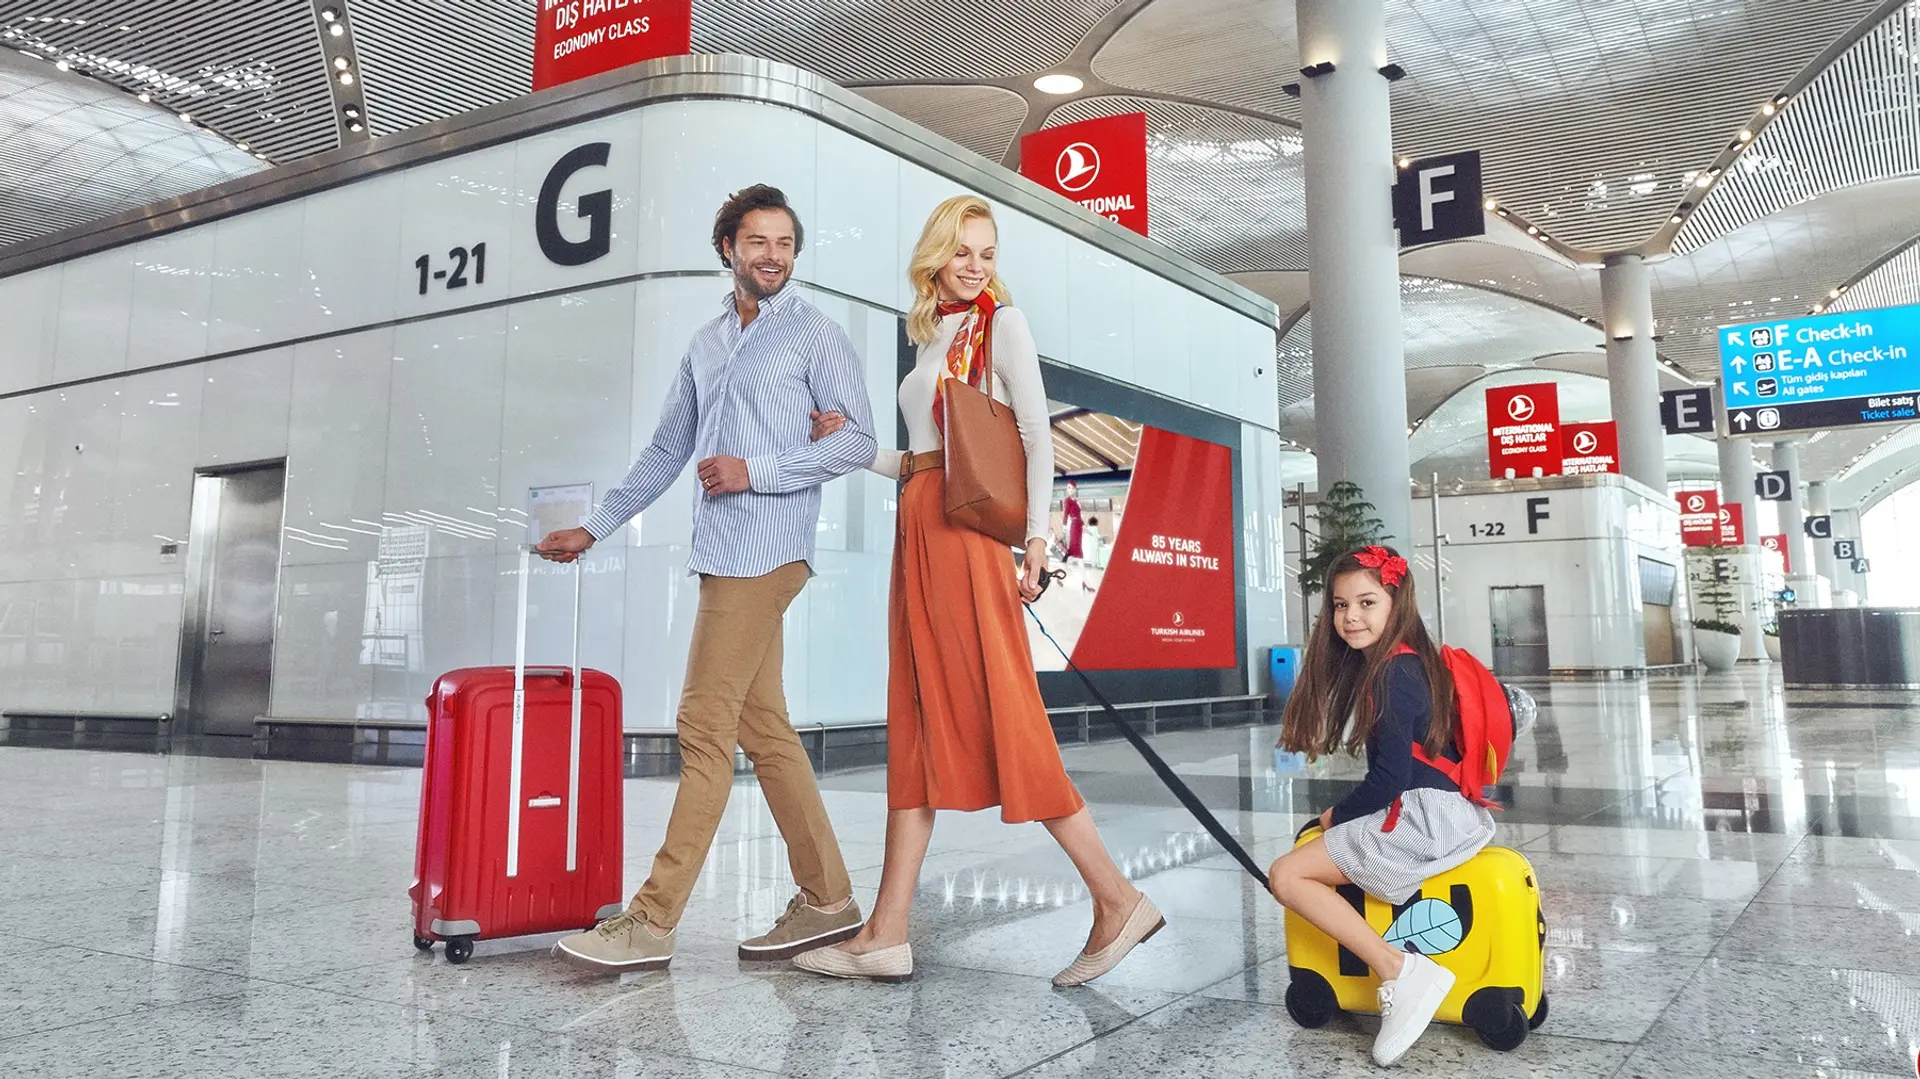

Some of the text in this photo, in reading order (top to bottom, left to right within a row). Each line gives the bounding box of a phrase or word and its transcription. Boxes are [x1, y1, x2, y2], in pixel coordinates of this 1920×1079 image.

[555, 1, 579, 30] DIŞ
[554, 16, 650, 60] ECONOMY CLASS
[535, 142, 613, 267] G
[1418, 164, 1455, 231] F
[415, 242, 486, 295] 1-21
[1774, 322, 1873, 346] F Check-in
[1777, 345, 1907, 371] E-A Check-in
[1781, 374, 1803, 384] Tüm
[1804, 371, 1828, 384] gidiş
[1782, 384, 1824, 396] All gates
[1675, 393, 1700, 428] E
[1868, 396, 1914, 409] Bilet satış
[1860, 407, 1916, 421] Ticket sales
[1492, 423, 1555, 436] INTERNATIONAL
[1501, 432, 1547, 446] DIŞ HATLAR
[1501, 445, 1547, 455] ECONOMY CLASS
[1762, 474, 1785, 499] D
[1469, 497, 1550, 537] 1-22 F
[1810, 518, 1827, 537] C
[1152, 534, 1201, 553] 85 YEARS
[1838, 542, 1852, 558] B
[1131, 548, 1219, 570] ALWAYS IN STYLE
[1857, 560, 1868, 572] A
[1150, 628, 1205, 637] TURKISH AIRLINES
